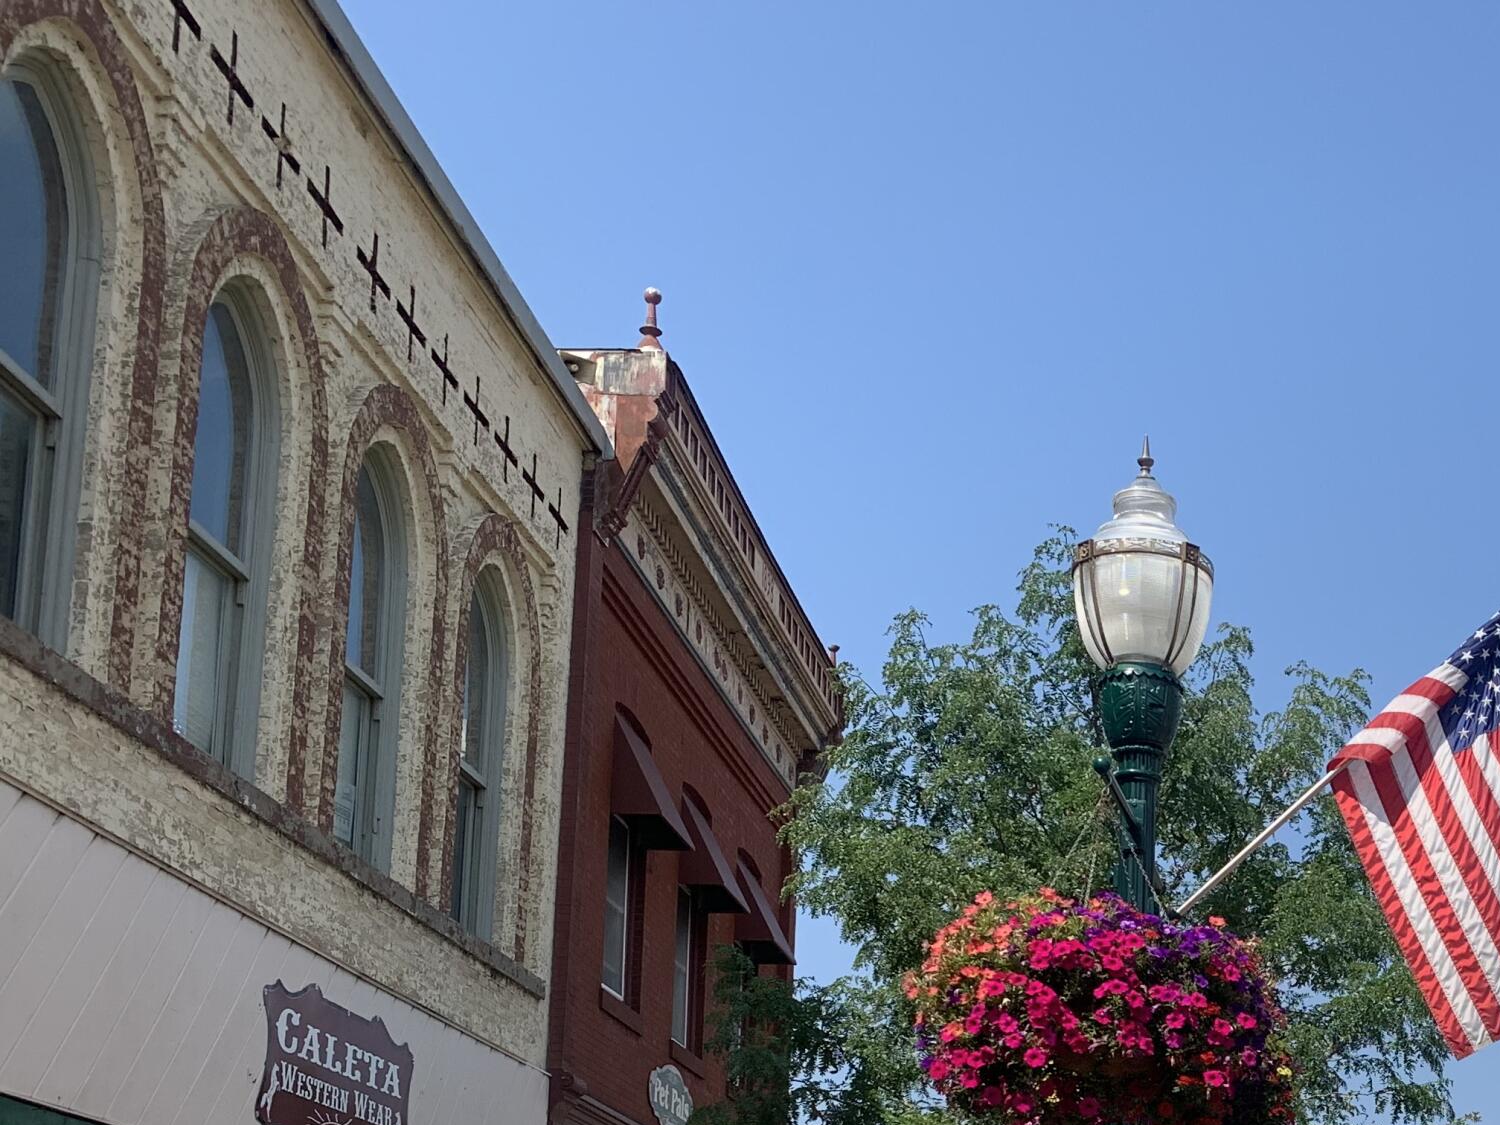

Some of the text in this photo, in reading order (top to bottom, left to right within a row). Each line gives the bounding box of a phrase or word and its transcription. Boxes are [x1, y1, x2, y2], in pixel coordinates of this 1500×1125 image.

[276, 1008, 402, 1099] CALETA
[280, 1060, 350, 1113] WESTERN
[654, 1078, 690, 1122] Pet Pals
